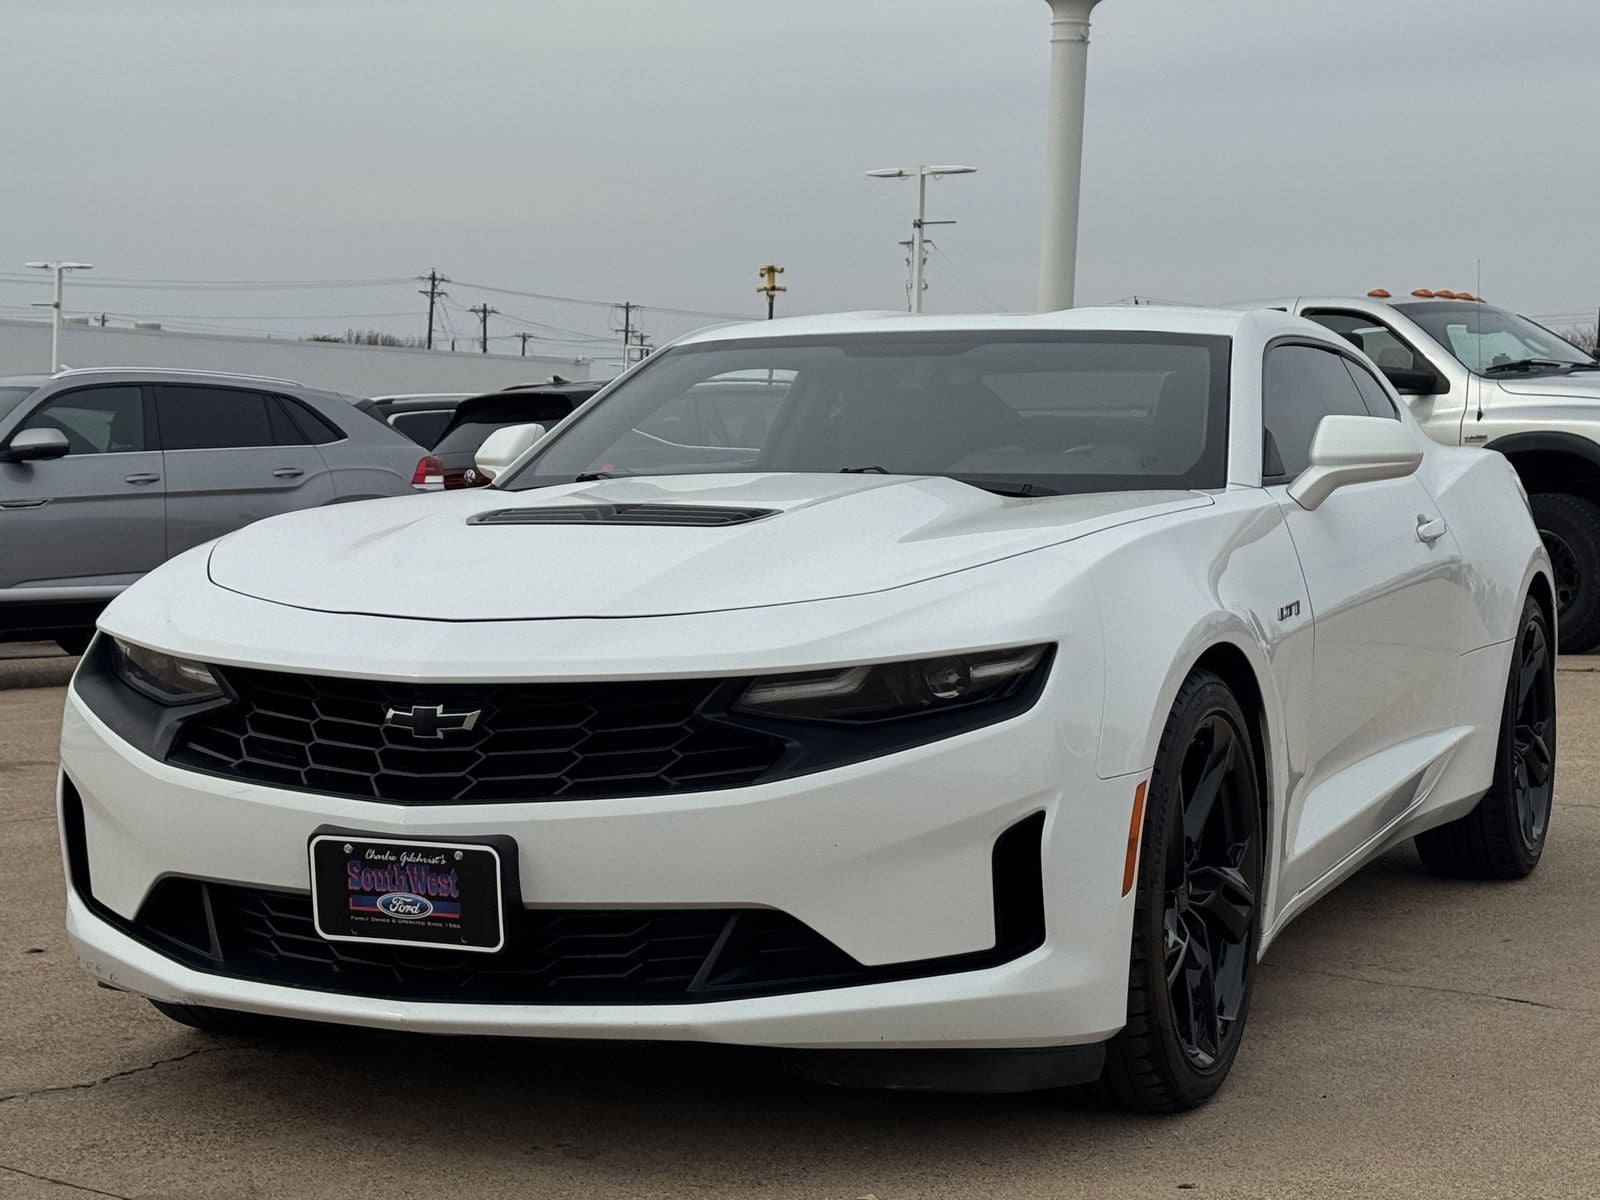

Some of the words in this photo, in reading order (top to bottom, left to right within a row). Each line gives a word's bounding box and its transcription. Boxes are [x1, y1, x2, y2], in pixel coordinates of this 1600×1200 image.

[1278, 600, 1300, 621] LT1
[365, 848, 397, 861] Charlie
[400, 851, 447, 866] Gilchrist's
[389, 896, 420, 914] Ford
